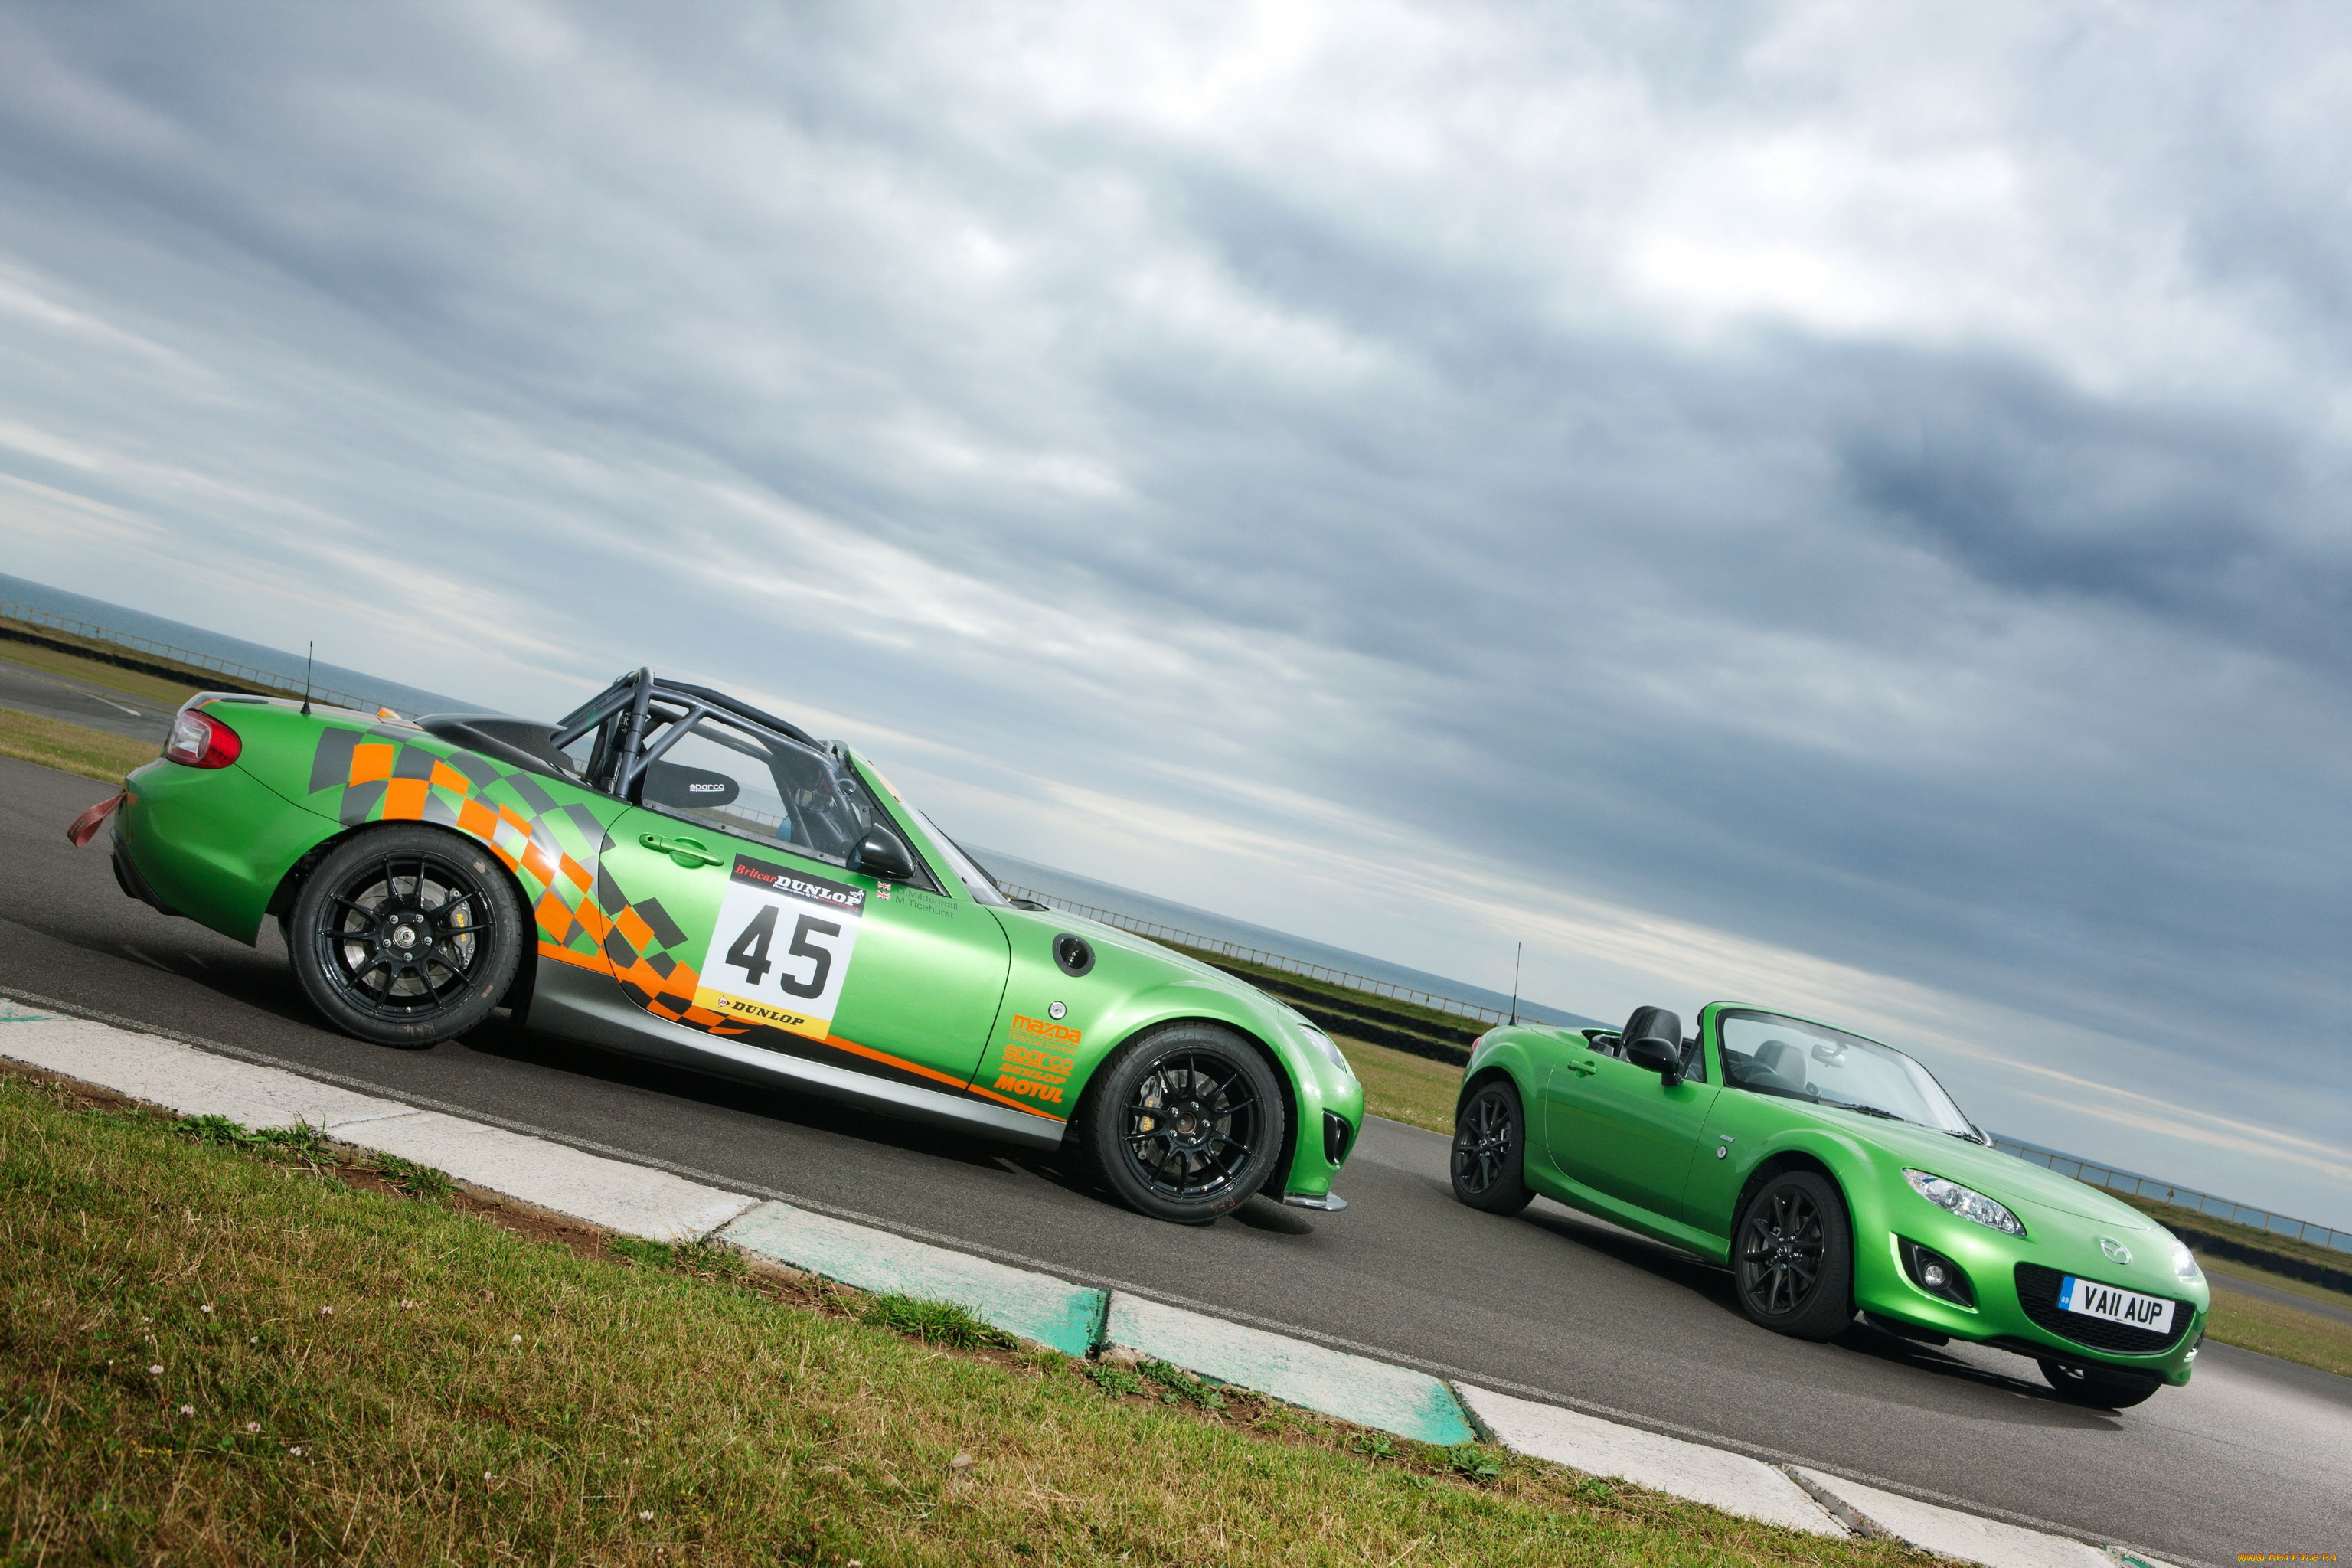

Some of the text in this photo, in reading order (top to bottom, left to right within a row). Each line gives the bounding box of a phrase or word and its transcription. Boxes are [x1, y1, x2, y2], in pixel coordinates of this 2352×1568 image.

[689, 783, 725, 792] sparco
[735, 864, 861, 906] Britcar DUNLOP
[773, 884, 805, 896] Production
[895, 896, 954, 919] M.Ticehurst
[725, 904, 841, 999] 45
[731, 1001, 805, 1026] DUNLOP
[1004, 1044, 1073, 1073] sparco
[999, 1063, 1067, 1085] DUNLOP
[994, 1074, 1064, 1104] MOTUL
[2085, 1285, 2163, 1325] VA11 AUP
